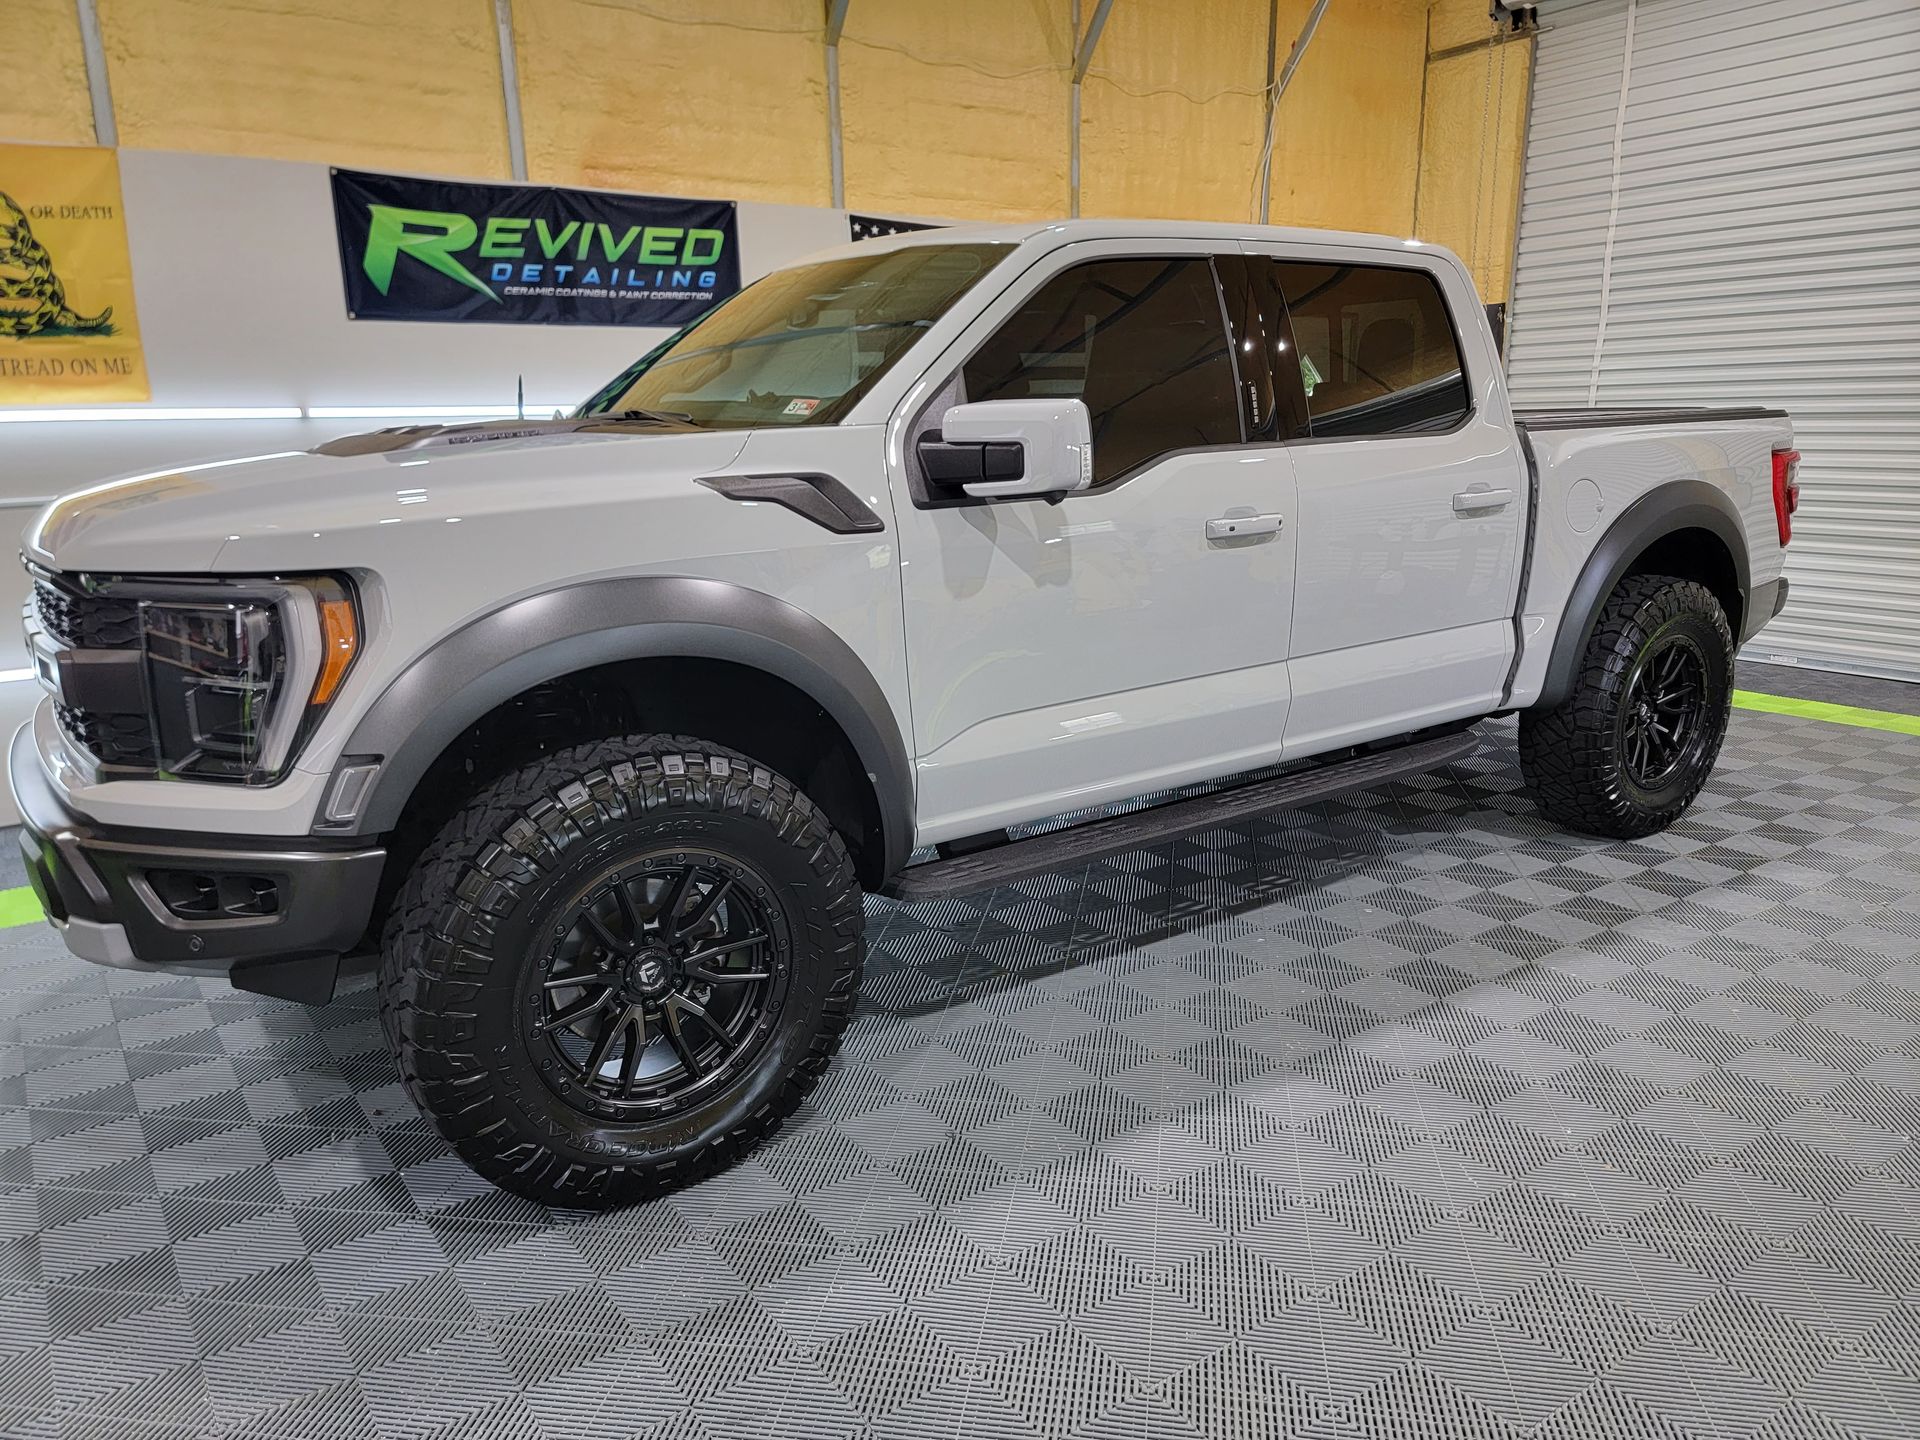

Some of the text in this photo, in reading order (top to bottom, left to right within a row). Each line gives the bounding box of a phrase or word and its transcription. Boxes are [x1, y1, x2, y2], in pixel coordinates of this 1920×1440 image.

[30, 205, 113, 219] OR DEATH
[362, 203, 724, 305] REVIVED
[490, 263, 717, 288] DETAILING
[503, 286, 713, 300] CERAMIC COATINGS & PAINT CORRECTION
[0, 357, 132, 376] TREAD ON ME
